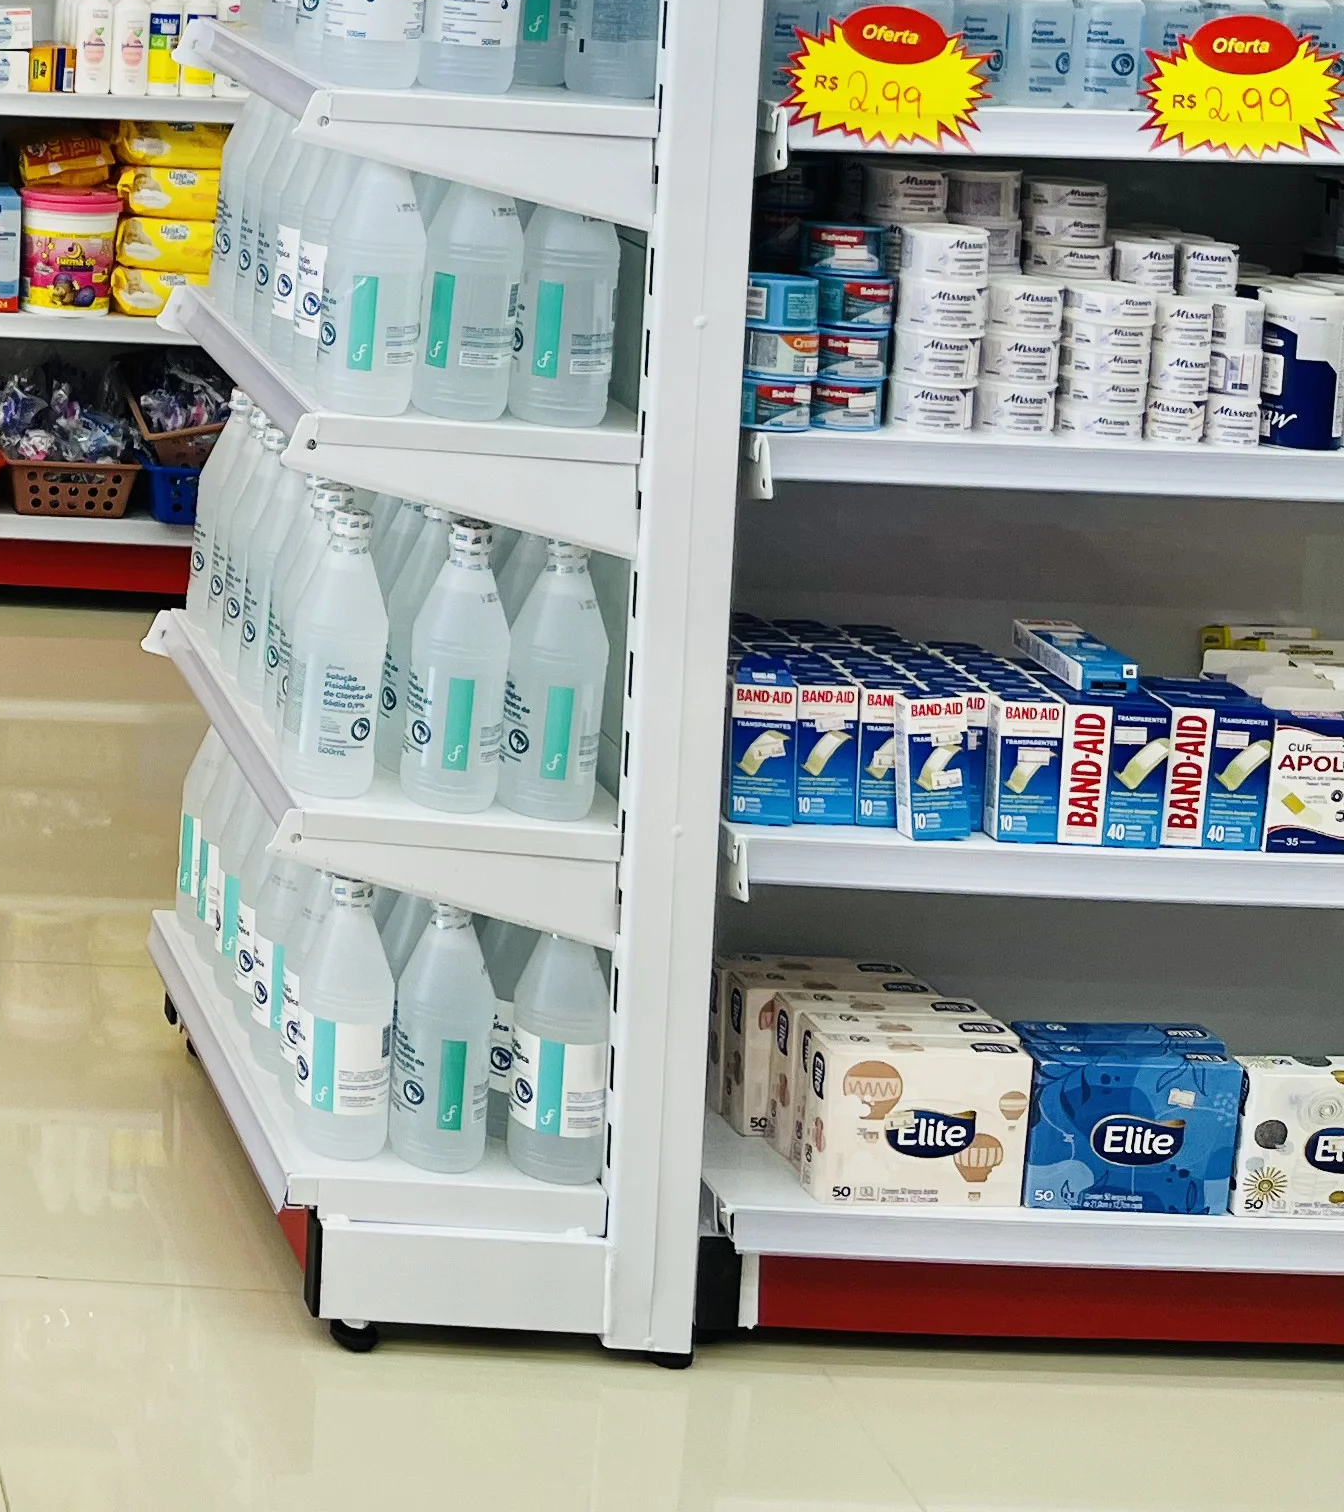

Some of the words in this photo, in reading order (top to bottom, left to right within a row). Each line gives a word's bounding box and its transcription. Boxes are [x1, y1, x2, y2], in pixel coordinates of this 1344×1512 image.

[862, 24, 919, 46] Oferta
[1211, 36, 1271, 55] Oferta
[814, 74, 839, 92] R$
[847, 68, 922, 119] 2,99
[1171, 93, 1197, 112] R$
[1204, 85, 1293, 125] 2,99
[737, 688, 792, 704] BAND-AID
[802, 689, 855, 704] BAND-AID
[912, 702, 963, 717] BAND-AID
[1006, 706, 1060, 721] BAND-AID
[1067, 713, 1106, 827] BAND-AID
[1168, 715, 1208, 829] BAND-AID
[732, 796, 745, 812] 10
[798, 797, 810, 813] 10
[860, 800, 872, 815] 10
[913, 813, 926, 829] 10
[1000, 815, 1012, 831] 10
[1107, 824, 1126, 841] 40
[1207, 826, 1226, 842] 40
[1286, 837, 1299, 847] 35
[1102, 1125, 1175, 1156] Elite
[831, 1185, 851, 1199] 50
[1034, 1189, 1054, 1202] 50
[1244, 1197, 1264, 1211] 50
